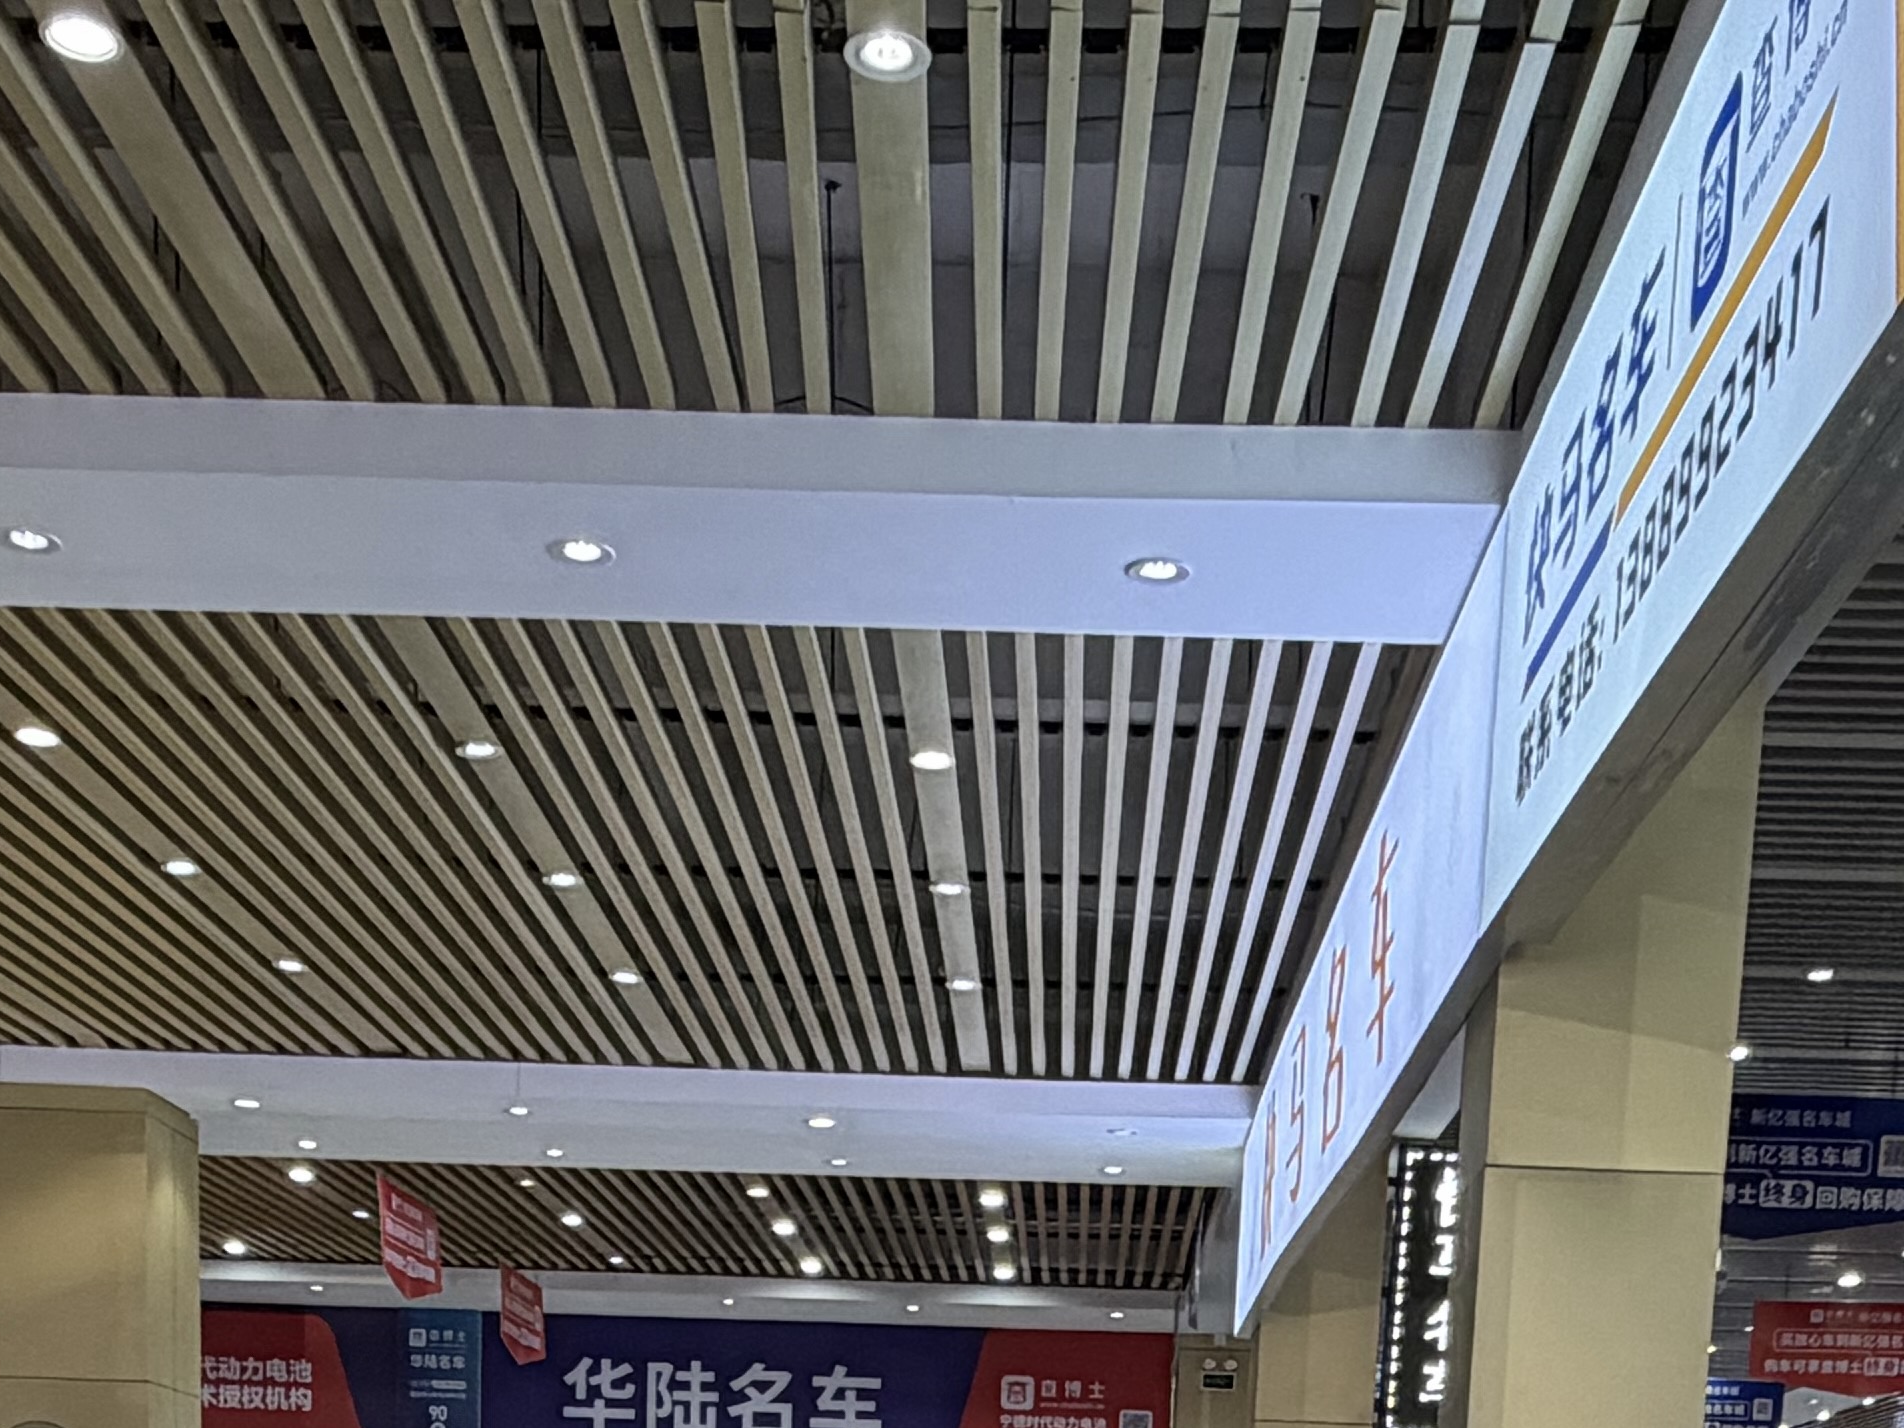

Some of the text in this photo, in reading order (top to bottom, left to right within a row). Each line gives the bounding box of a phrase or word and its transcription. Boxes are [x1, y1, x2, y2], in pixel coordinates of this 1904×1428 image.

[1523, 244, 1667, 649] 快马名车
[1614, 193, 1830, 646] 13889923417
[428, 1405, 448, 1421] 90
